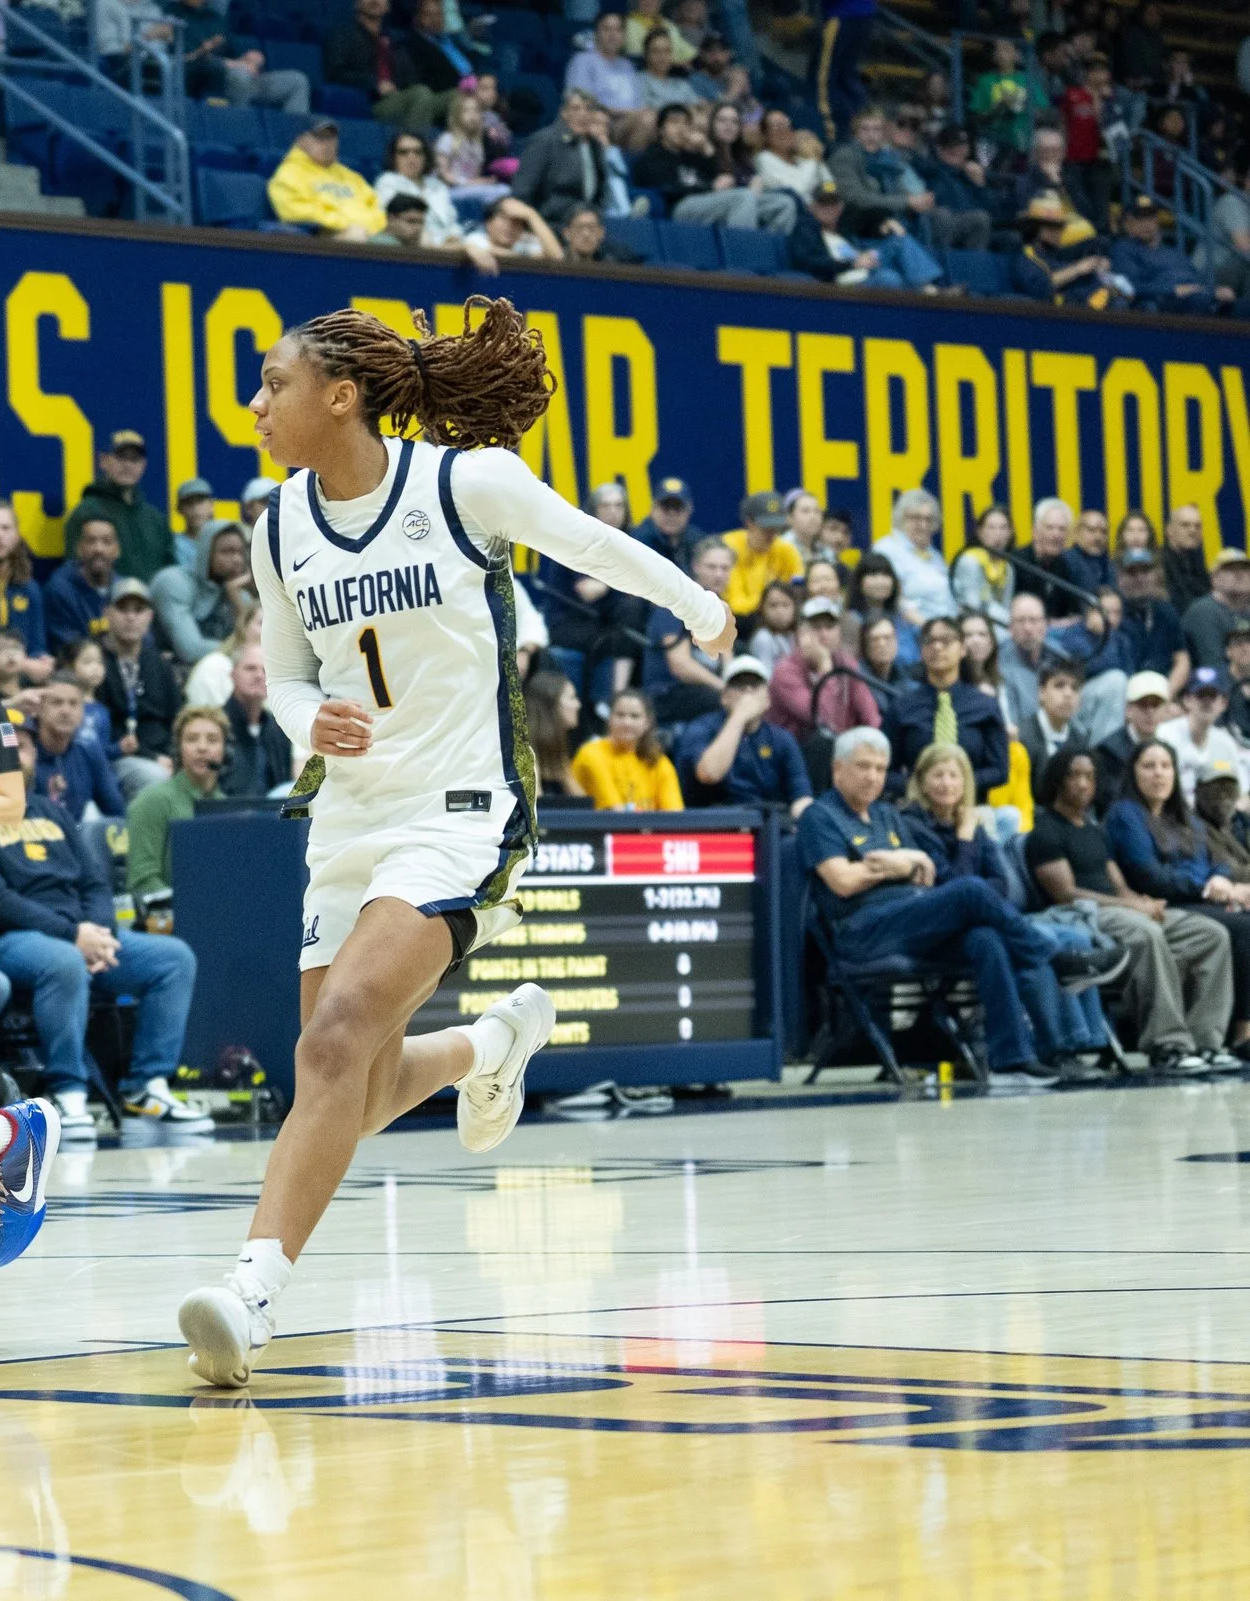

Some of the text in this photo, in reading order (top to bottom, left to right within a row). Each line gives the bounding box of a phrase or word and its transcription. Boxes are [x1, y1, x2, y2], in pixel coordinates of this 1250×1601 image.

[406, 518, 429, 528] ACC
[297, 563, 443, 631] CALIFORNIA
[358, 626, 394, 709] 1
[478, 796, 484, 806] L
[539, 843, 595, 873] STATS
[662, 840, 700, 873] SMU
[303, 914, 320, 948] al
[677, 952, 692, 976] 0
[678, 984, 692, 1008] 0
[679, 1017, 693, 1040] 0
